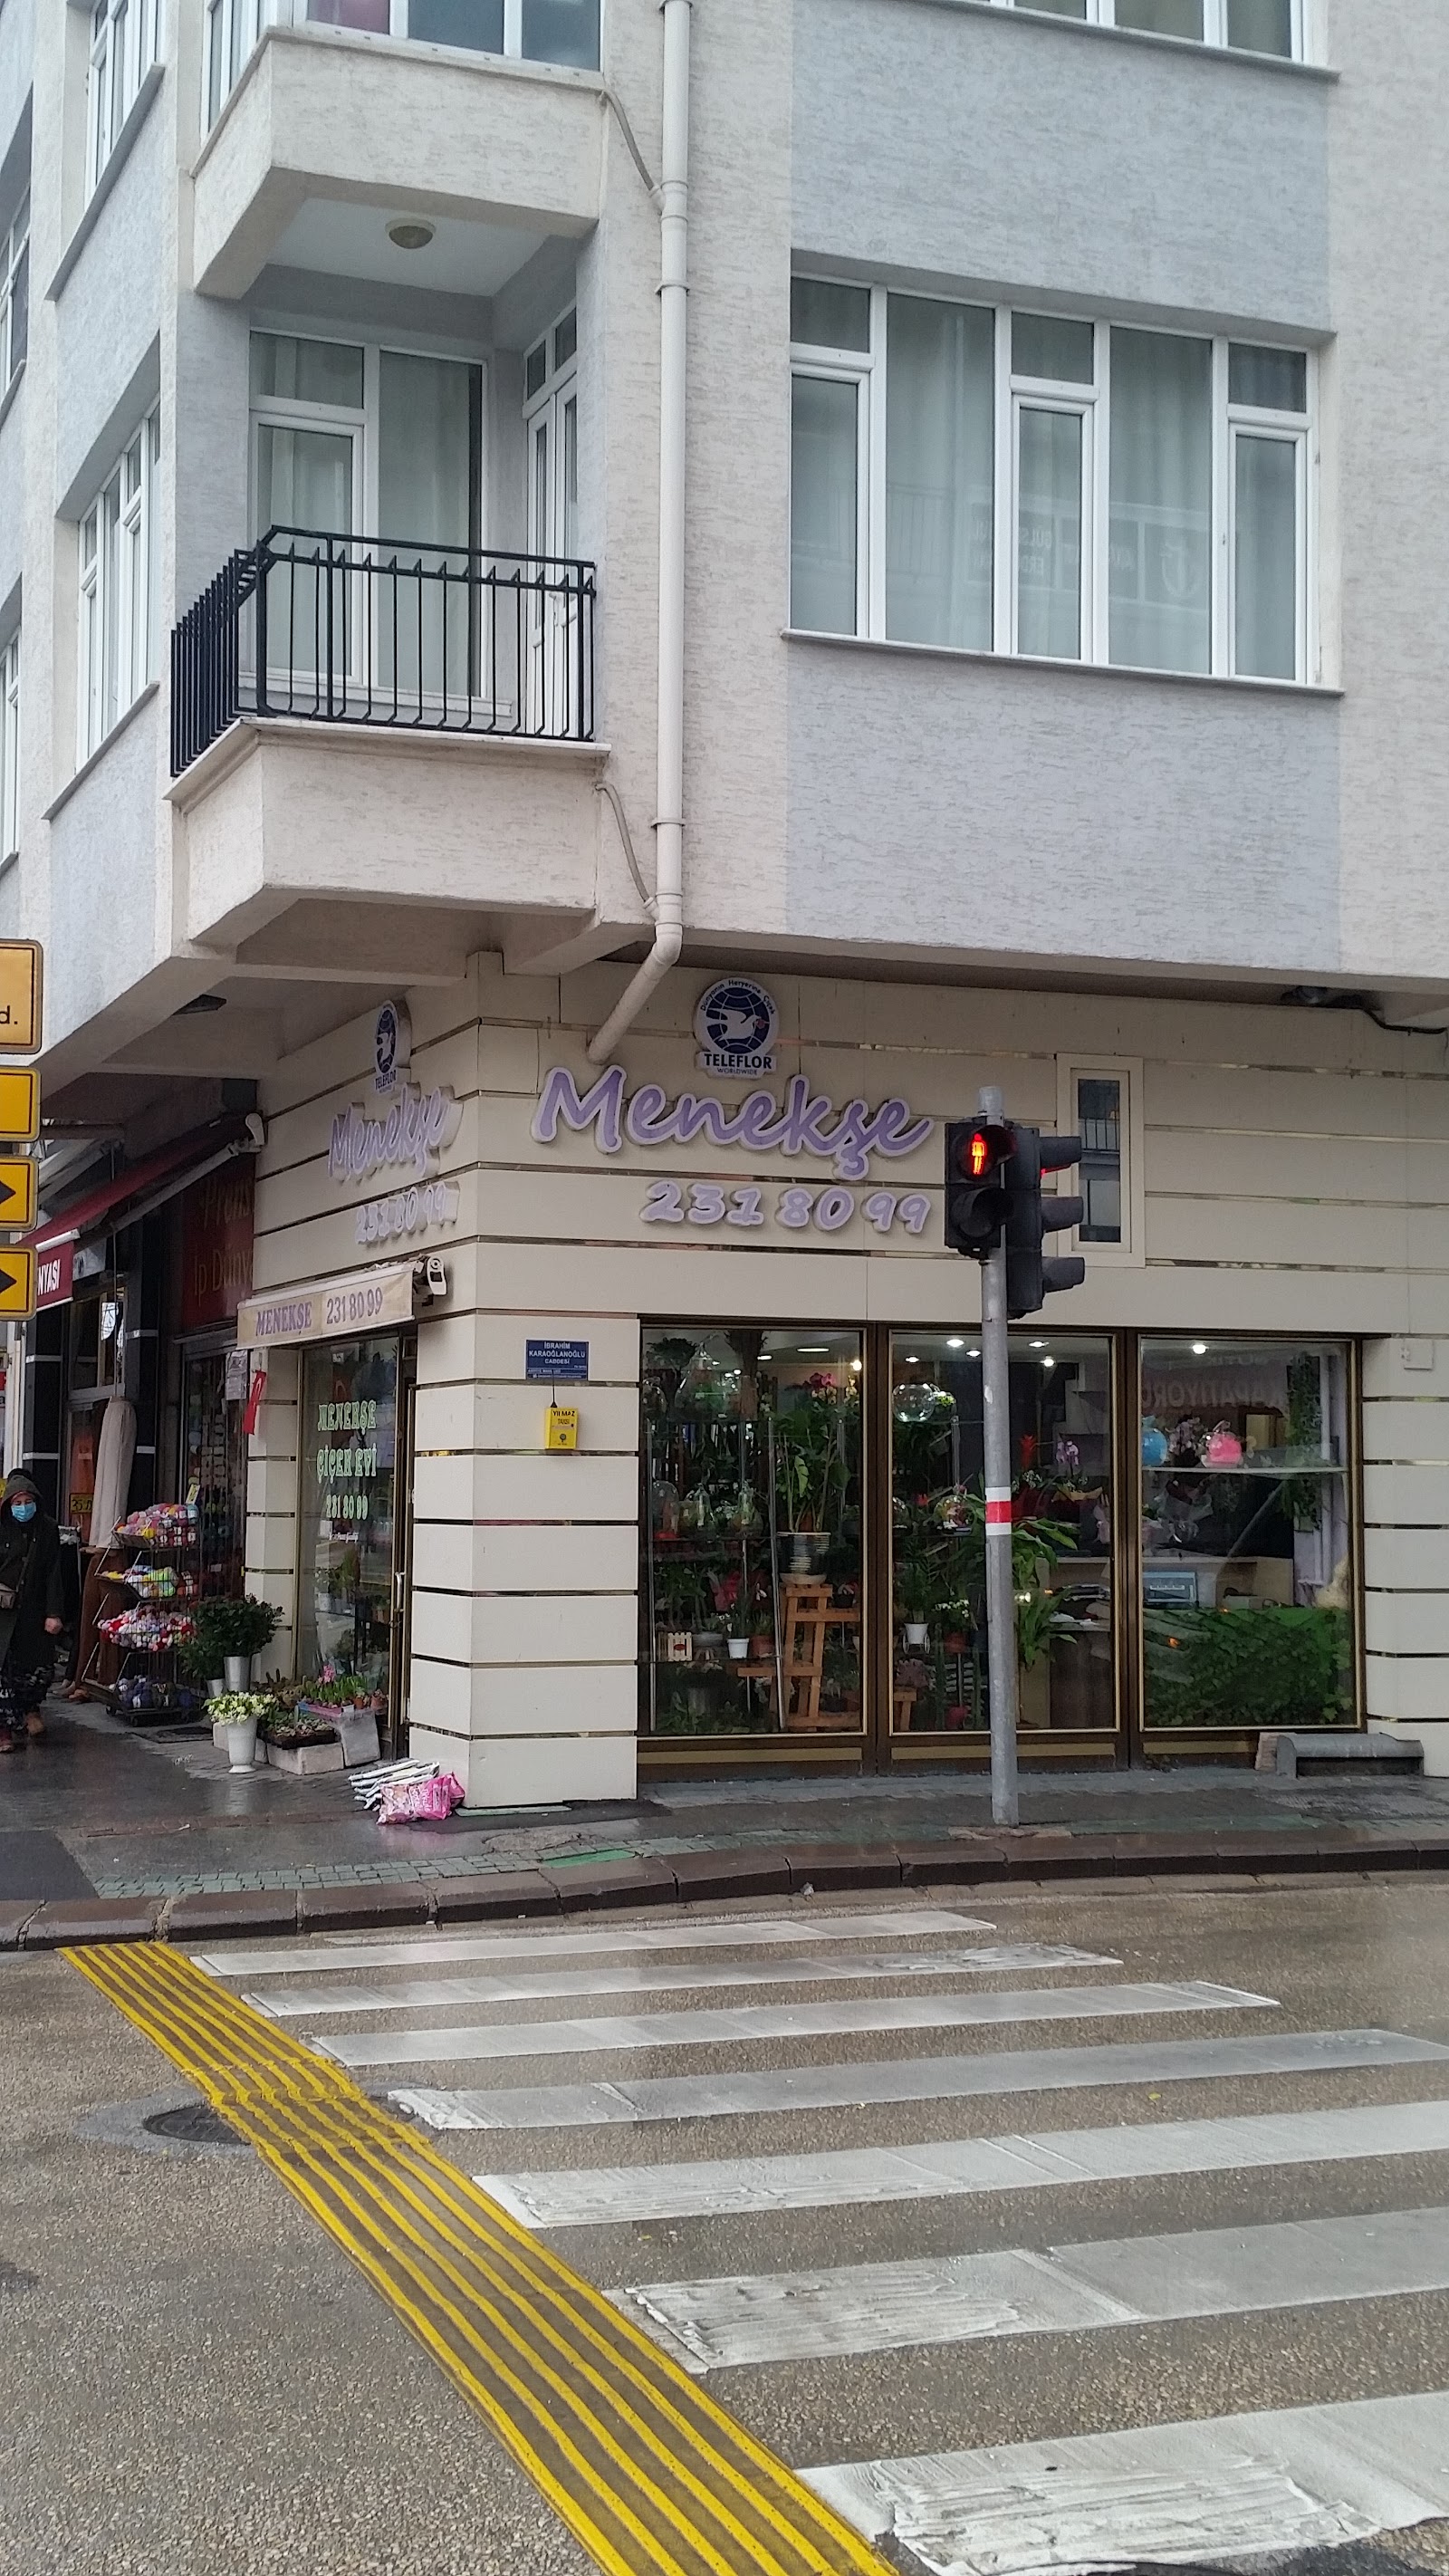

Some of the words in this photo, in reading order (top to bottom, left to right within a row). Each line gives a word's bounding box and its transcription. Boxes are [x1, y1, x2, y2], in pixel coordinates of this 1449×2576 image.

[375, 1070, 397, 1091] TELEFLOR
[704, 1053, 772, 1070] TELEFLOR
[327, 1082, 455, 1178] Menekşe
[533, 1065, 934, 1180] Menekşe
[640, 1181, 764, 1226] 231
[777, 1187, 855, 1231] 80
[863, 1191, 931, 1234] 99
[255, 1302, 312, 1337] MENEKŞE
[326, 1295, 346, 1324] 231
[349, 1292, 364, 1321] 80
[367, 1287, 383, 1316] 99
[544, 1341, 571, 1350] İBRAHİM
[318, 1399, 377, 1435] MENEKŞE
[317, 1444, 353, 1484] ÇİÇEK
[354, 1443, 377, 1477] EVİ
[326, 1495, 341, 1519] 231
[343, 1495, 354, 1520] 80
[356, 1495, 369, 1521] 99
